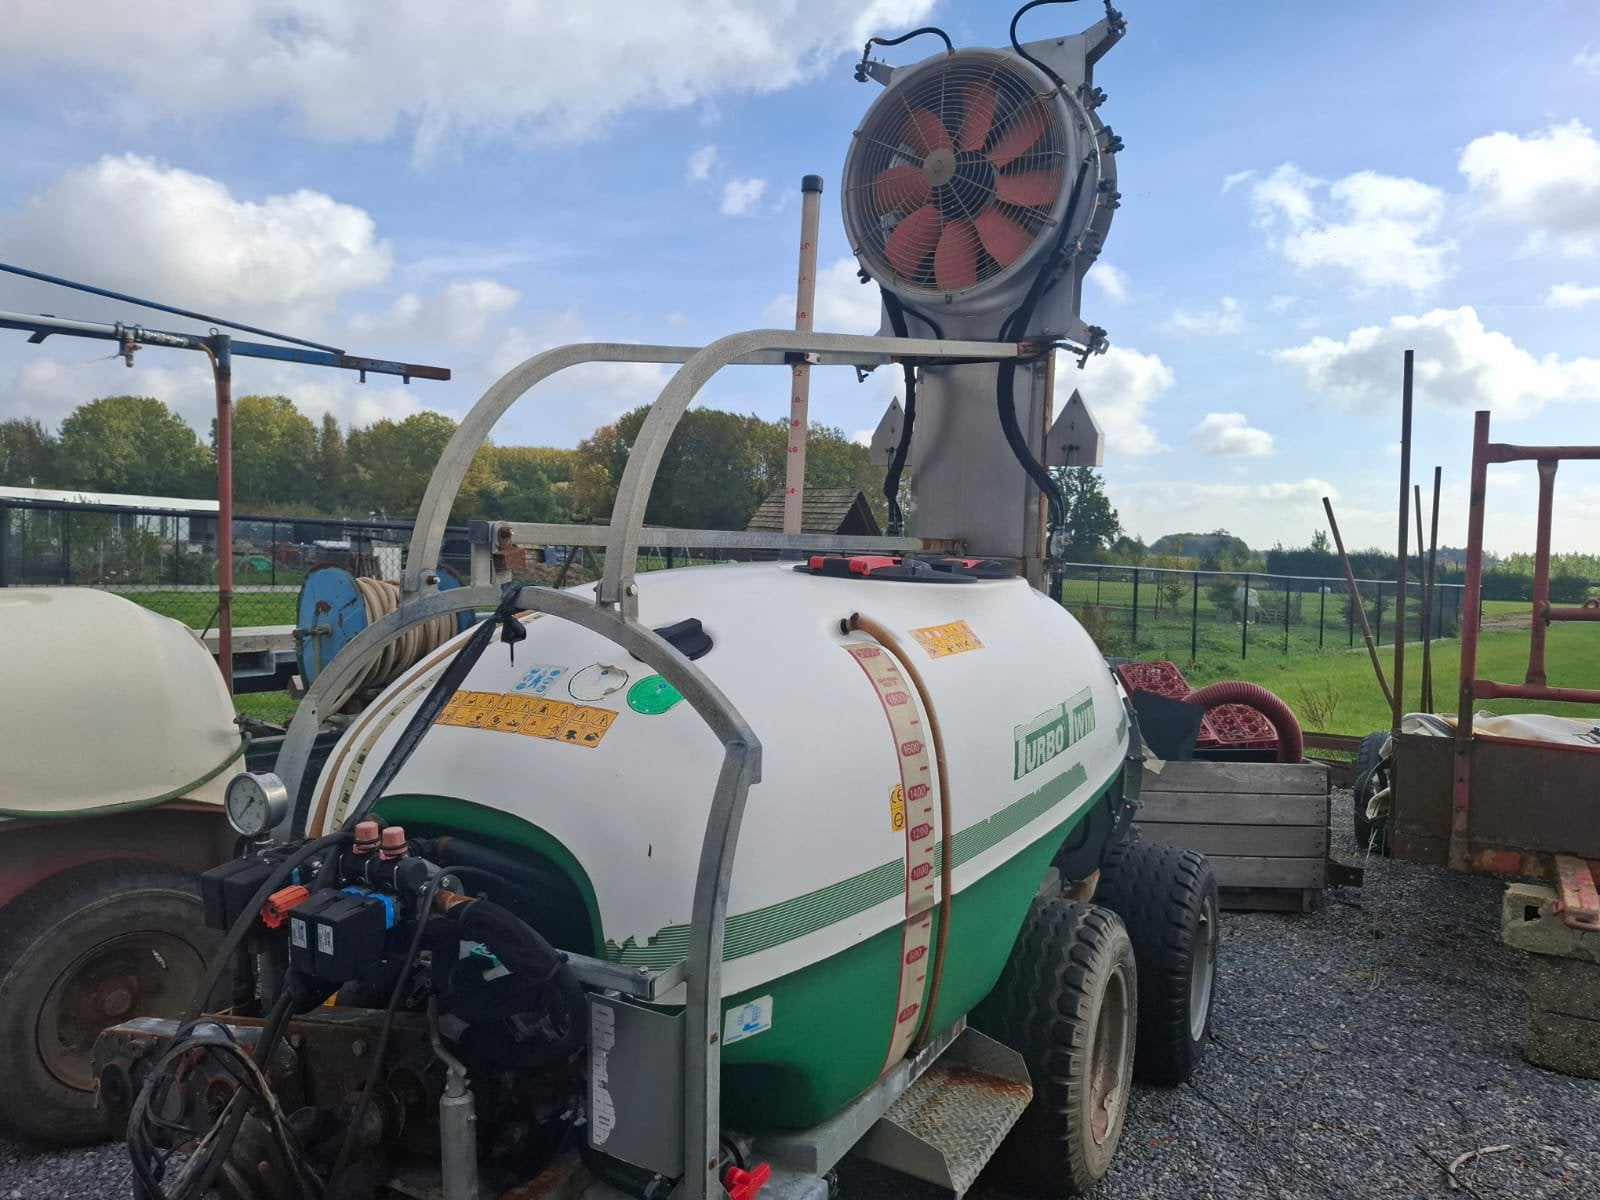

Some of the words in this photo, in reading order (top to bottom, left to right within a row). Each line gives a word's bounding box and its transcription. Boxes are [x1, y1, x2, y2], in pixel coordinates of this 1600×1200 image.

[886, 692, 906, 706] 1800
[903, 741, 920, 755] 1600
[1014, 710, 1065, 780] TURBO
[909, 785, 926, 800] 1400
[911, 824, 929, 840] 1200
[912, 864, 929, 879] 1000
